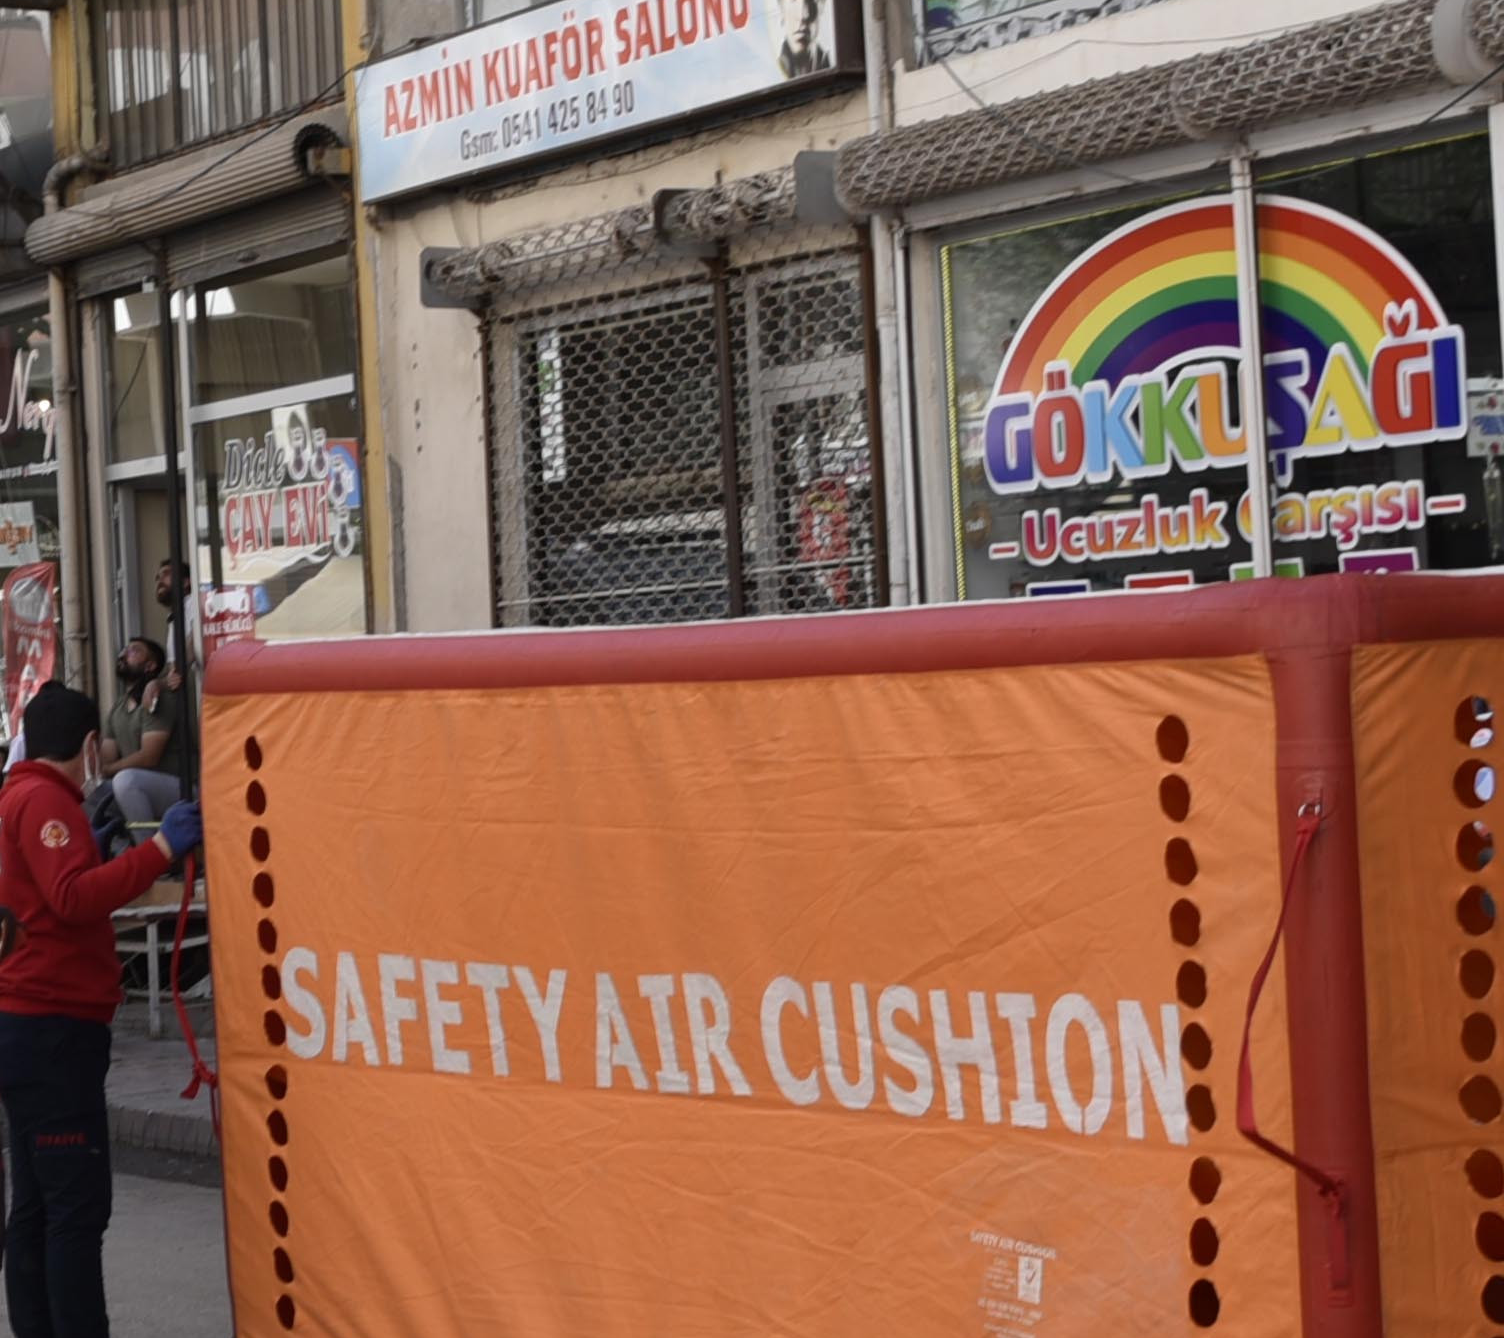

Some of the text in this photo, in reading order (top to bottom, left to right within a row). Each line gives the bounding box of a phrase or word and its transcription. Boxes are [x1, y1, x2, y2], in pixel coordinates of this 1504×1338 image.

[383, 49, 476, 139] AZMİN
[483, 12, 606, 109] KUAFÖR
[460, 81, 635, 161] Gsm: 0541 425 84 90
[985, 301, 1465, 489] GÖKKUŞAĞI
[223, 430, 286, 490] Dicle
[224, 489, 276, 570] ÇAY
[1023, 490, 1230, 565] Ucuzluk
[279, 946, 1190, 1146] SAFETY AIR CUSHION
